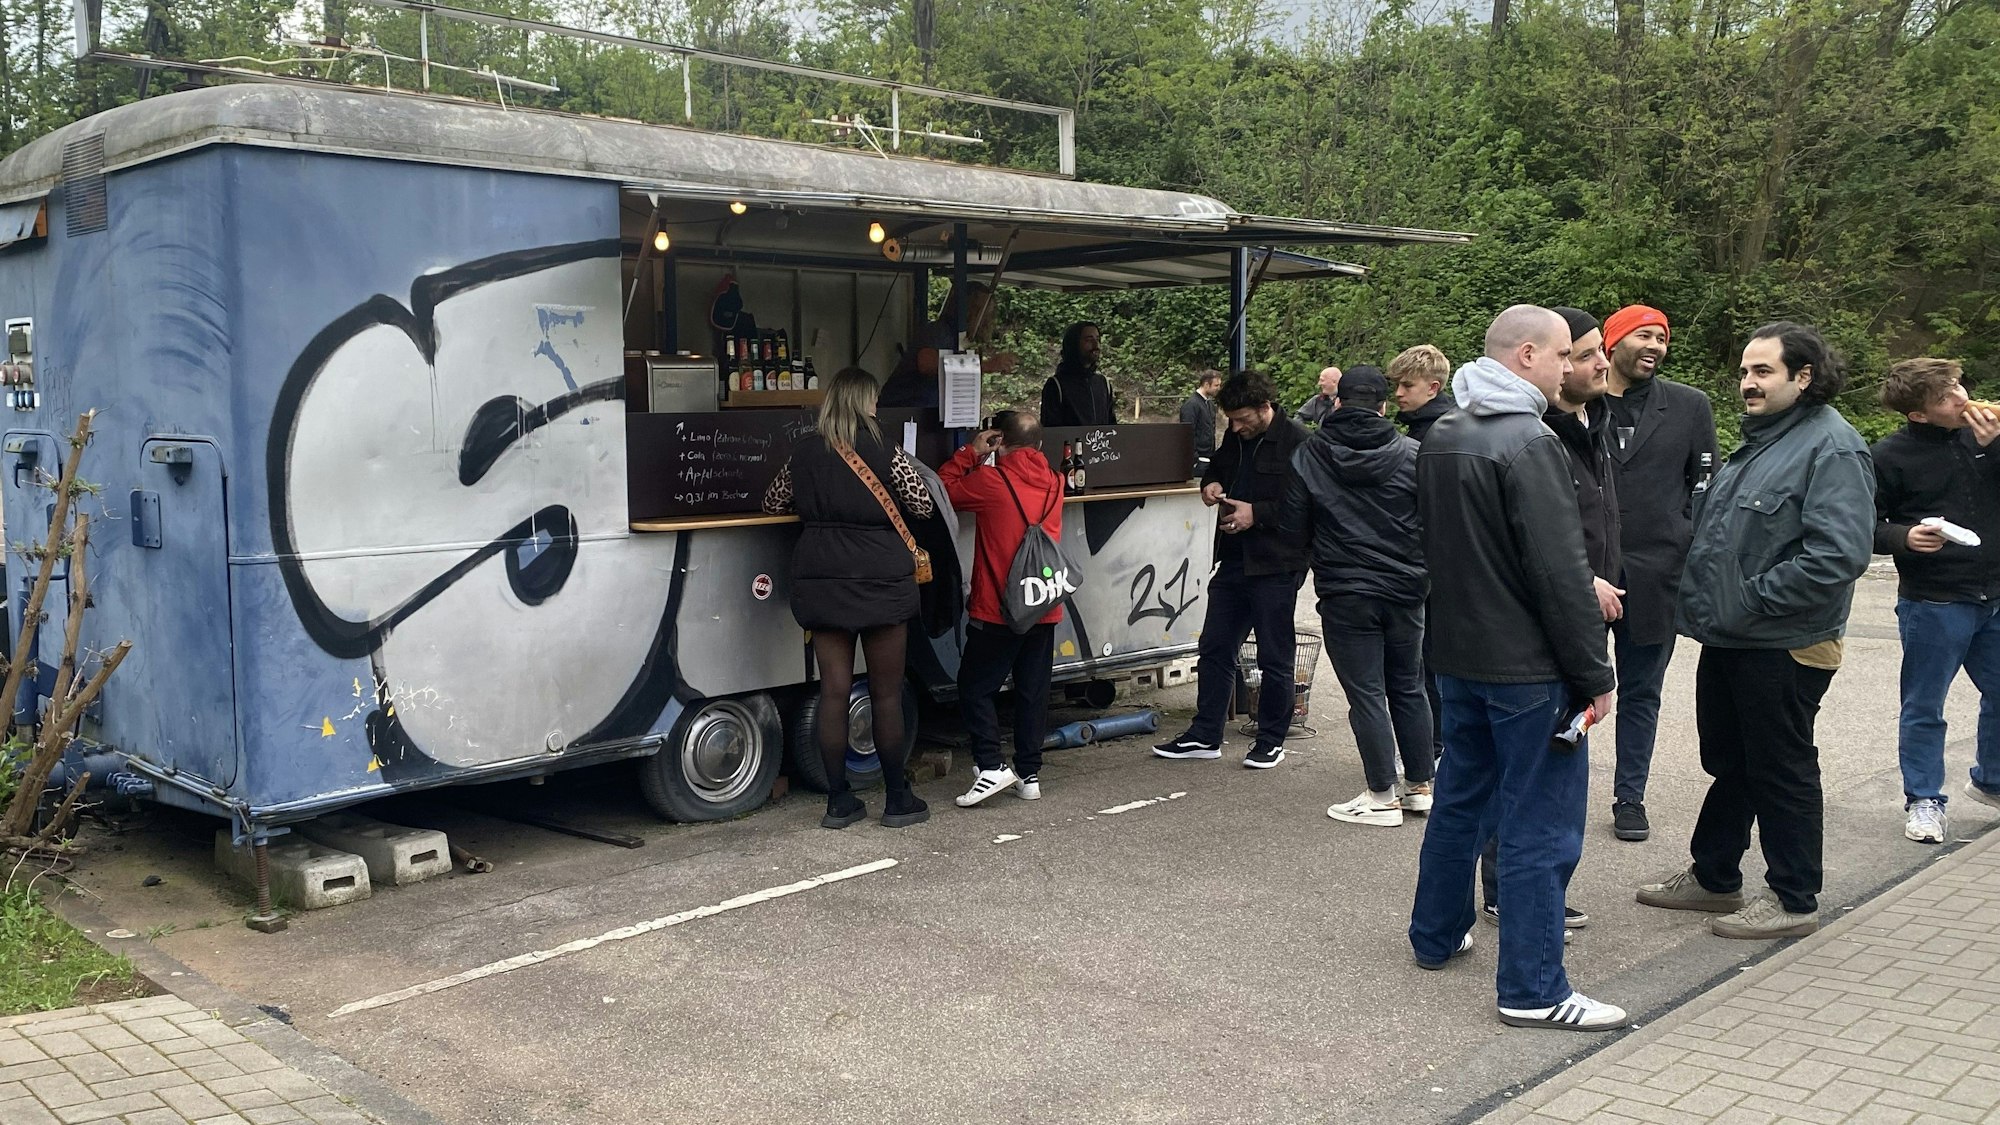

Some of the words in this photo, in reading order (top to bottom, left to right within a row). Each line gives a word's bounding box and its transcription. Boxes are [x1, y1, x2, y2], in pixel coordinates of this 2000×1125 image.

[690, 431, 711, 442] Limo
[687, 450, 706, 461] Cola
[707, 490, 719, 500] im
